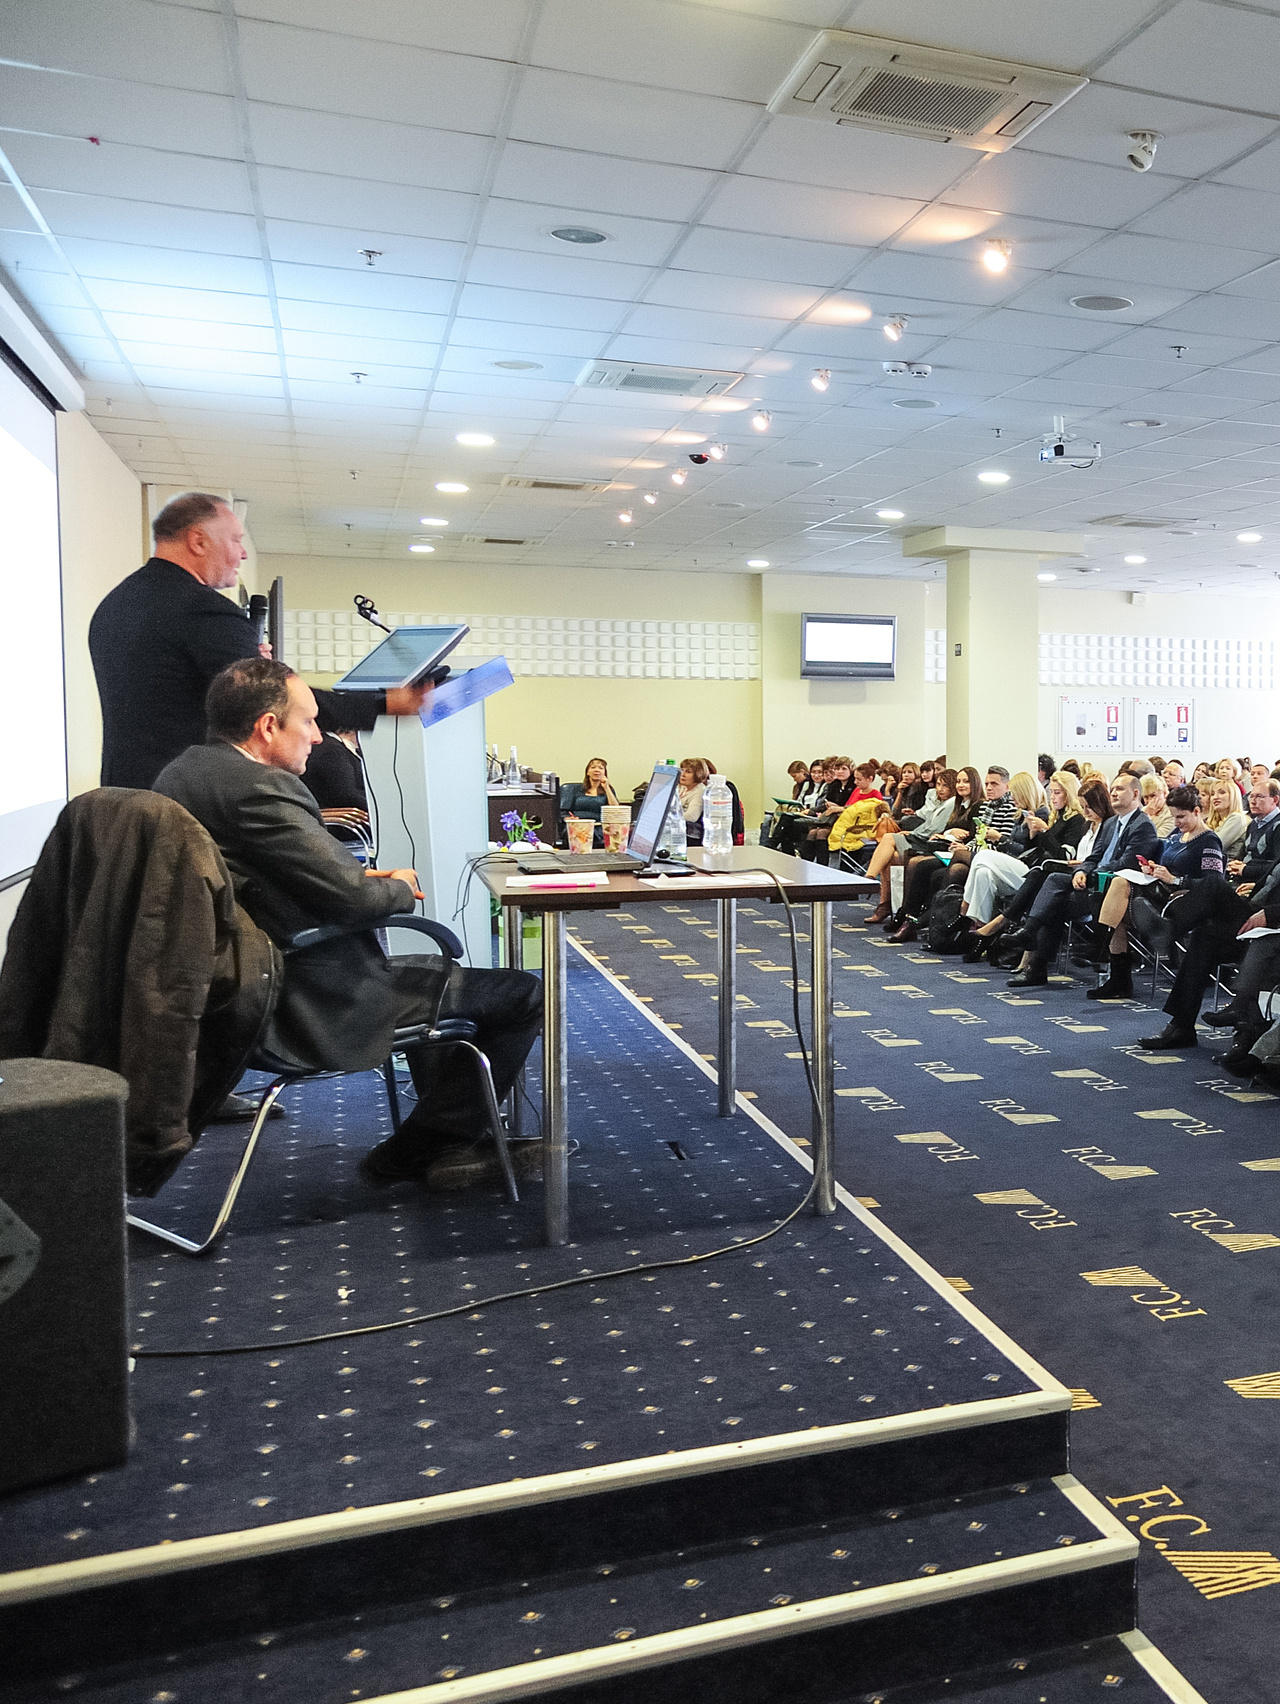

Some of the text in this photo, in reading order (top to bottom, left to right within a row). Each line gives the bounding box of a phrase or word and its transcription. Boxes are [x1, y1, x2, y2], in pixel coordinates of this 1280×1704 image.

[1061, 1146, 1117, 1166] F.C.
[1016, 1204, 1078, 1230] F.C.
[1169, 1208, 1235, 1235] F.C.
[1131, 1285, 1208, 1322] F.C.
[1106, 1485, 1212, 1551] F.C.
